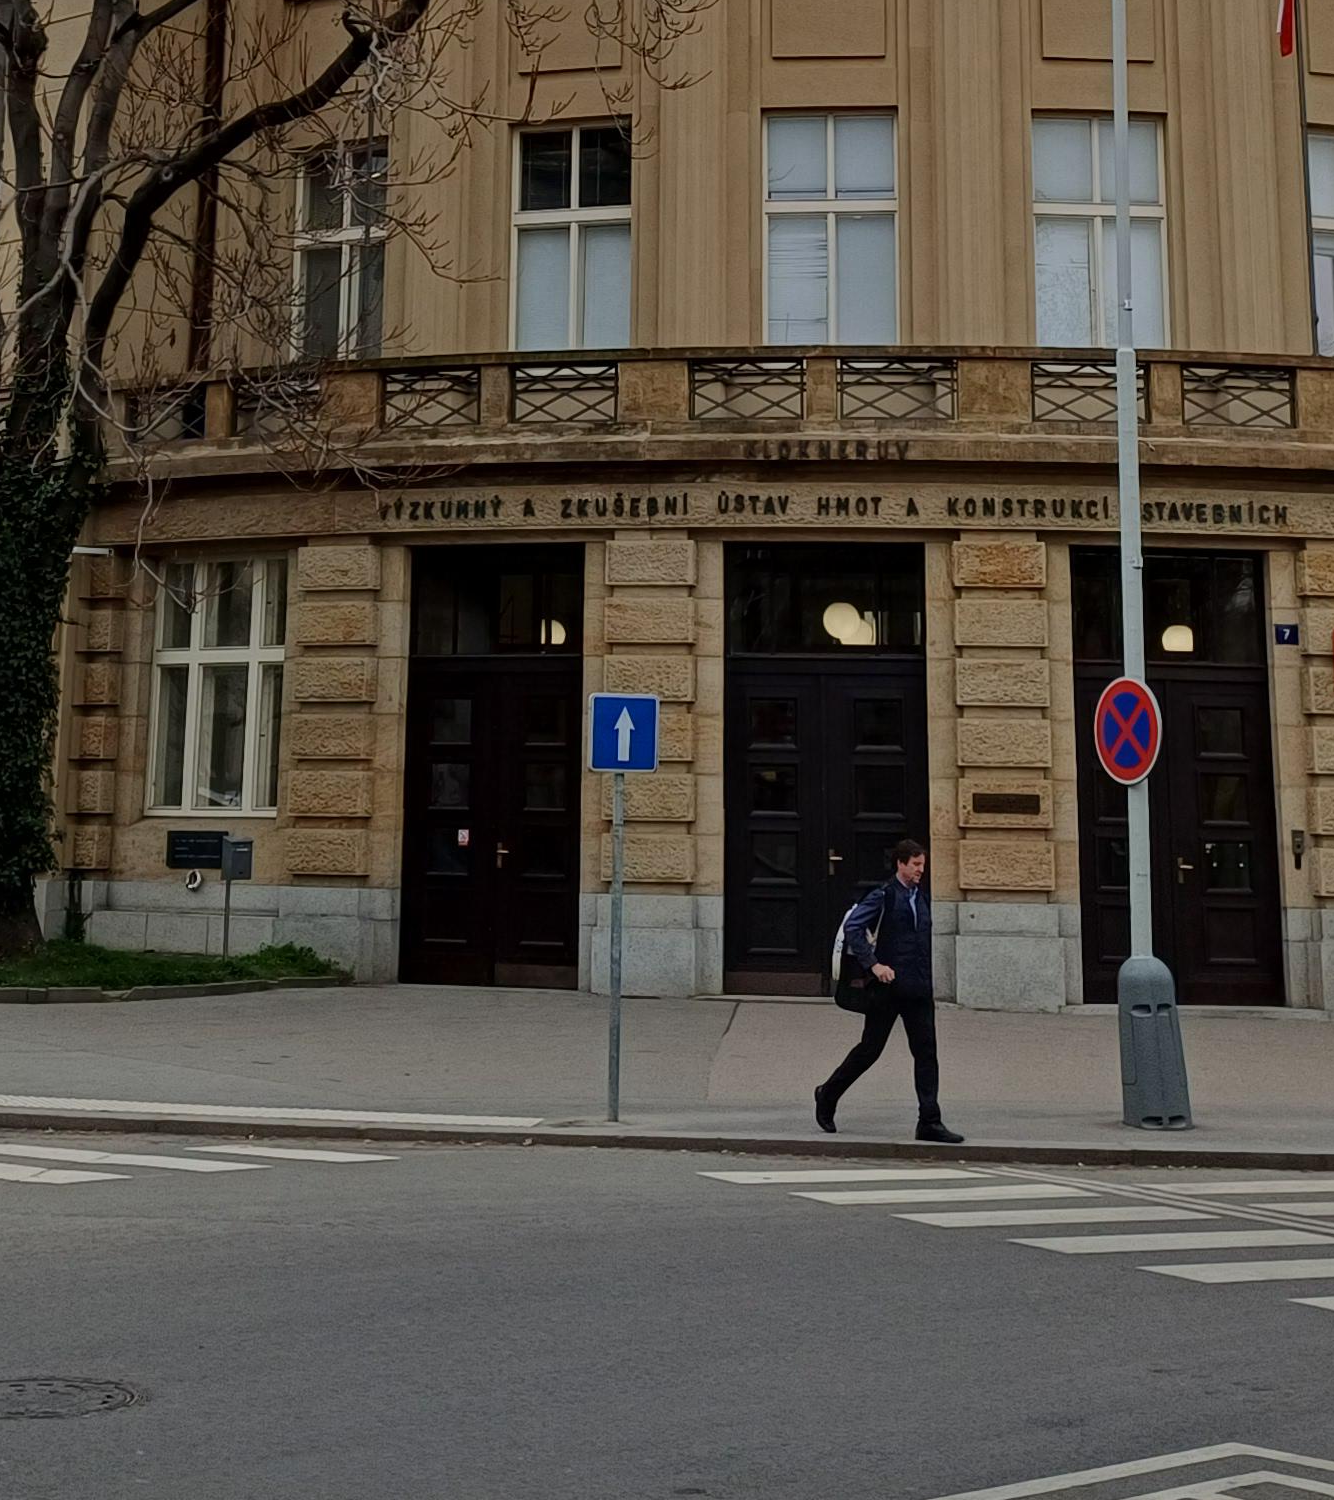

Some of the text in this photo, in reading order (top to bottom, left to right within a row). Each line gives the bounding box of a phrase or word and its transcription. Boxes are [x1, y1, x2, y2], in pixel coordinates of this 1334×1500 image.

[523, 498, 535, 518] A
[561, 492, 688, 518] ZKUŠEBNÍ
[817, 496, 882, 516] HMOT
[906, 497, 919, 517] A
[947, 496, 1109, 520] KONSTRUKCÍ
[1141, 499, 1288, 526] STAVEBNÍCH
[1283, 628, 1290, 640] 7
